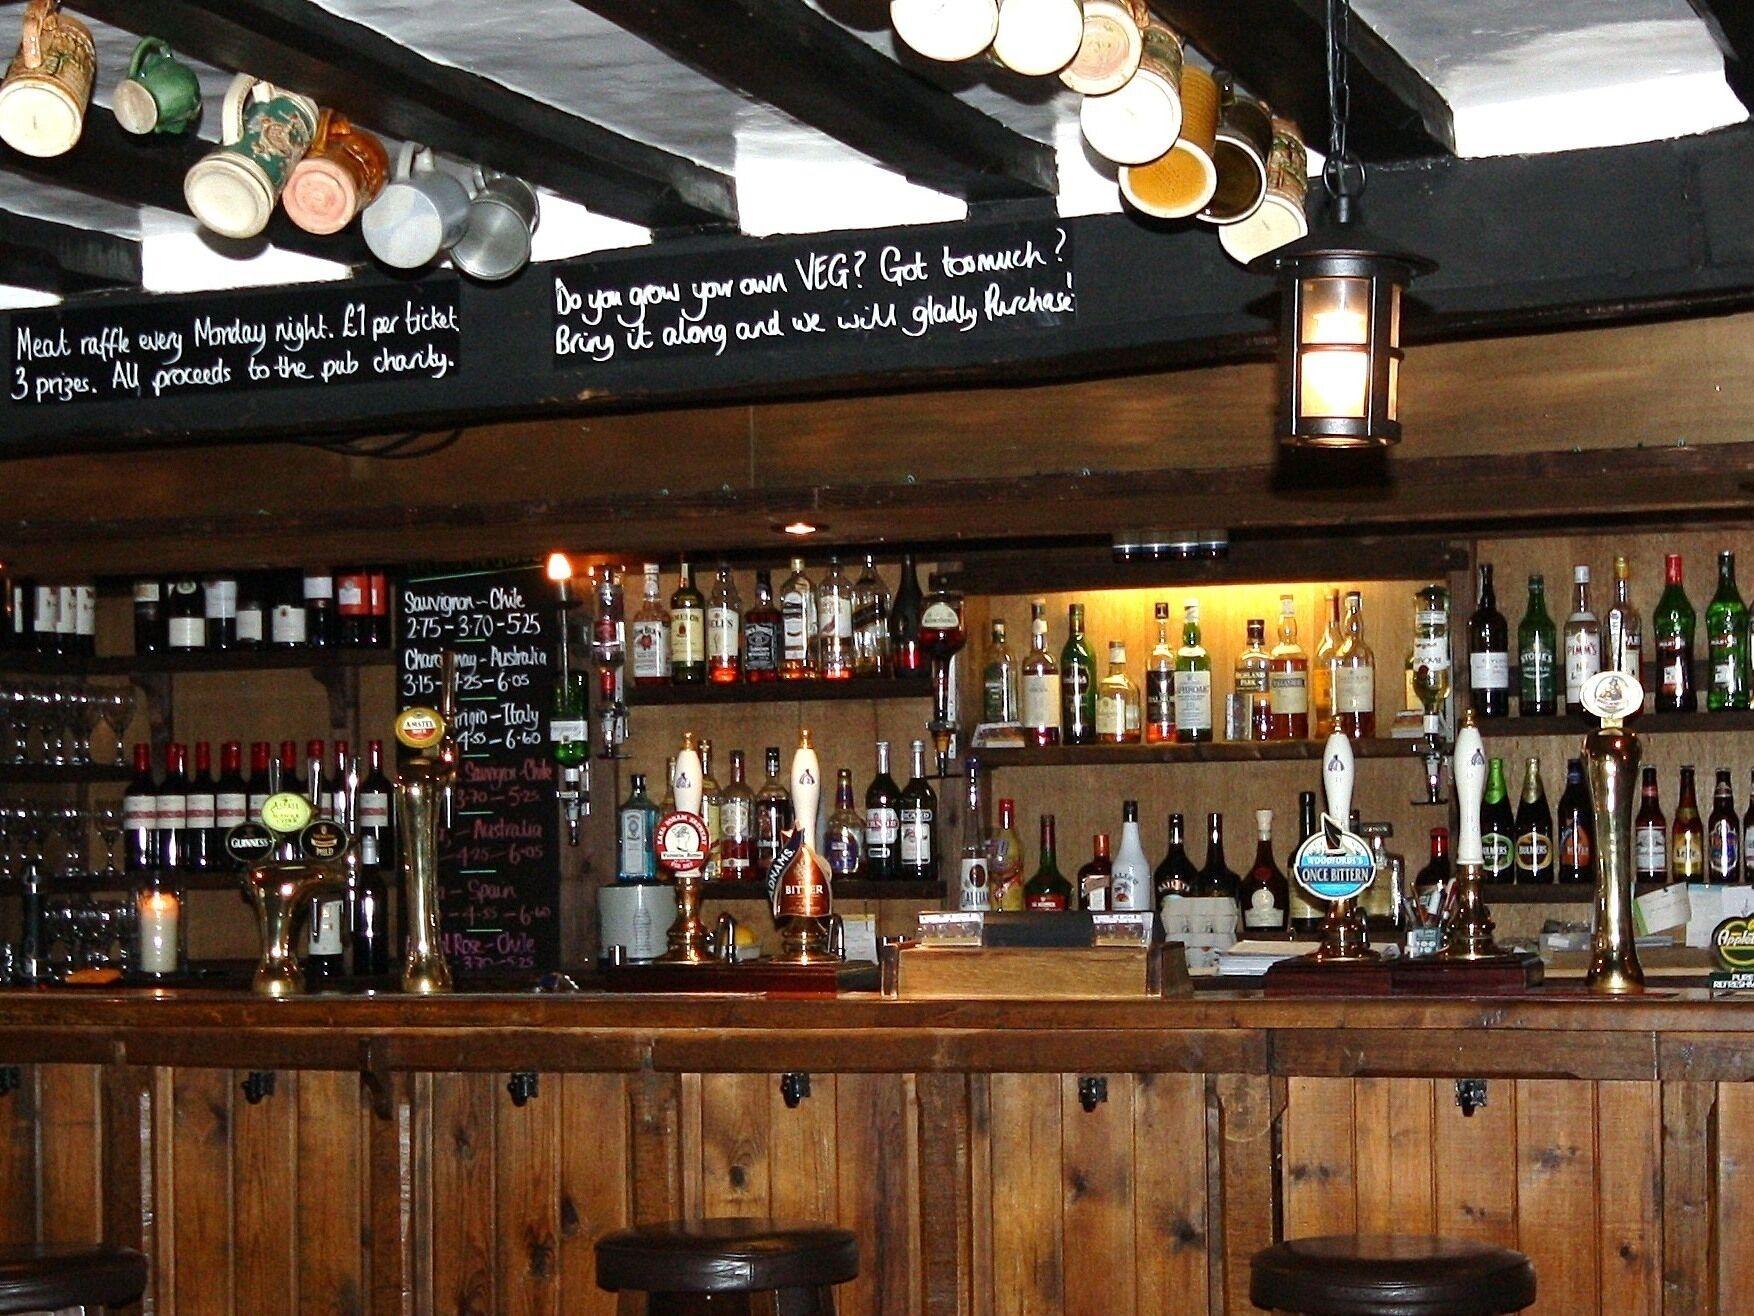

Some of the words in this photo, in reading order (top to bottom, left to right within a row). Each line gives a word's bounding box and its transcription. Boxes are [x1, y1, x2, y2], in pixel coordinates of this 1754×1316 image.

[555, 278, 582, 316] Do
[587, 286, 622, 326] you
[629, 282, 680, 327] grow
[681, 277, 733, 320] your
[740, 274, 788, 295] own
[794, 250, 865, 292] VEG?
[880, 246, 928, 286] Got
[17, 327, 71, 360] Meat
[81, 327, 131, 361] raffle
[139, 329, 184, 364] every
[194, 318, 267, 355] Monday
[274, 314, 334, 351] night.
[342, 303, 366, 337] £1
[373, 316, 399, 342] per
[556, 322, 615, 361] Bring
[626, 321, 654, 351] it
[662, 313, 728, 357] along
[735, 309, 781, 340] and
[792, 311, 826, 333] we
[837, 300, 898, 330] will
[902, 295, 978, 337] gladly
[11, 365, 29, 399] 3
[36, 372, 97, 402] prizes.
[112, 362, 140, 388] All
[152, 358, 232, 395] proceeds
[248, 355, 270, 380] to
[273, 354, 313, 381] the
[320, 350, 359, 383] pub
[373, 343, 454, 379] charity.
[404, 591, 473, 618] Sauvignon
[490, 588, 525, 611] Chile
[1521, 651, 1553, 664] STOE'S
[454, 707, 488, 735] rigio
[500, 703, 539, 730] Italy
[231, 838, 269, 849] GUINNESS
[1518, 845, 1547, 855] BULERS
[1302, 867, 1330, 882] ONCE
[1330, 867, 1370, 882] BITTERN
